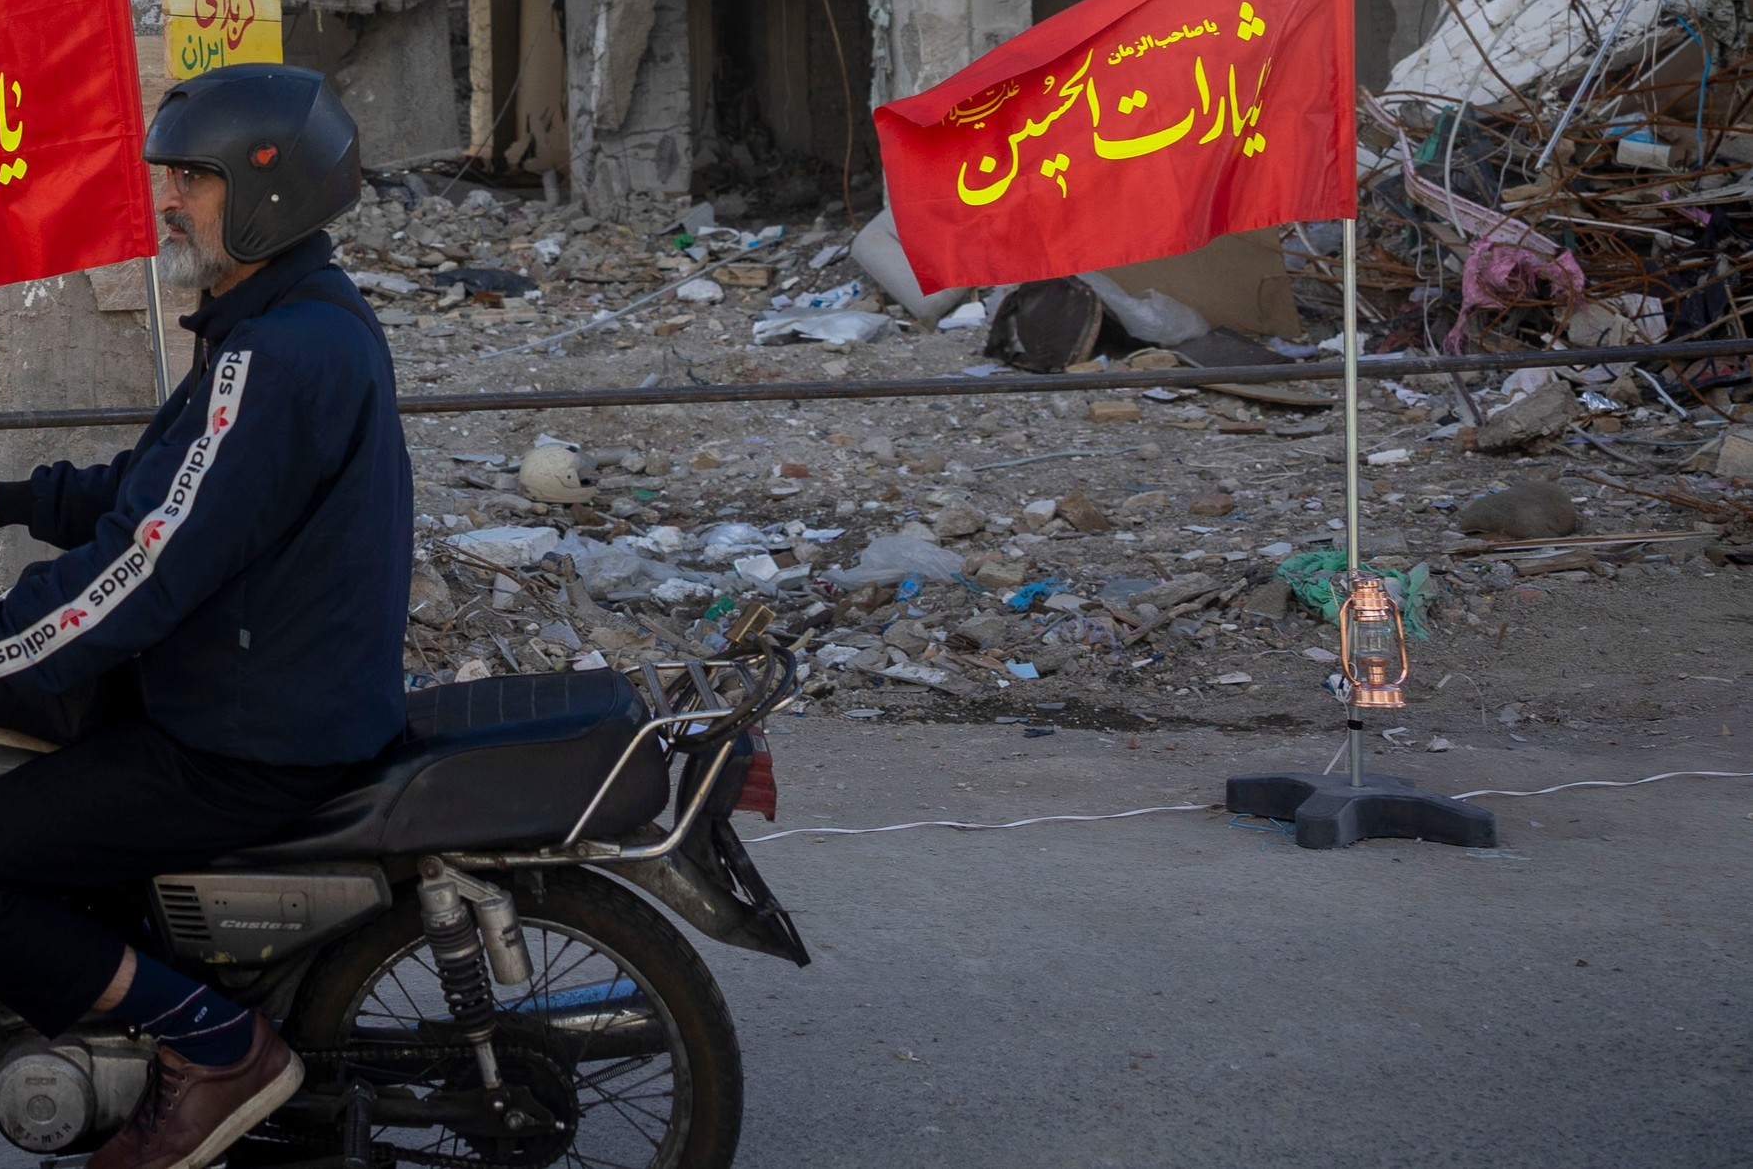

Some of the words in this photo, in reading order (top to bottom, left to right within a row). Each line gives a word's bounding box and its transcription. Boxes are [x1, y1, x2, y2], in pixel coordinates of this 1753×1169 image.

[181, 34, 225, 73] ایران
[88, 545, 148, 608] didas
[219, 918, 303, 931] Custom
